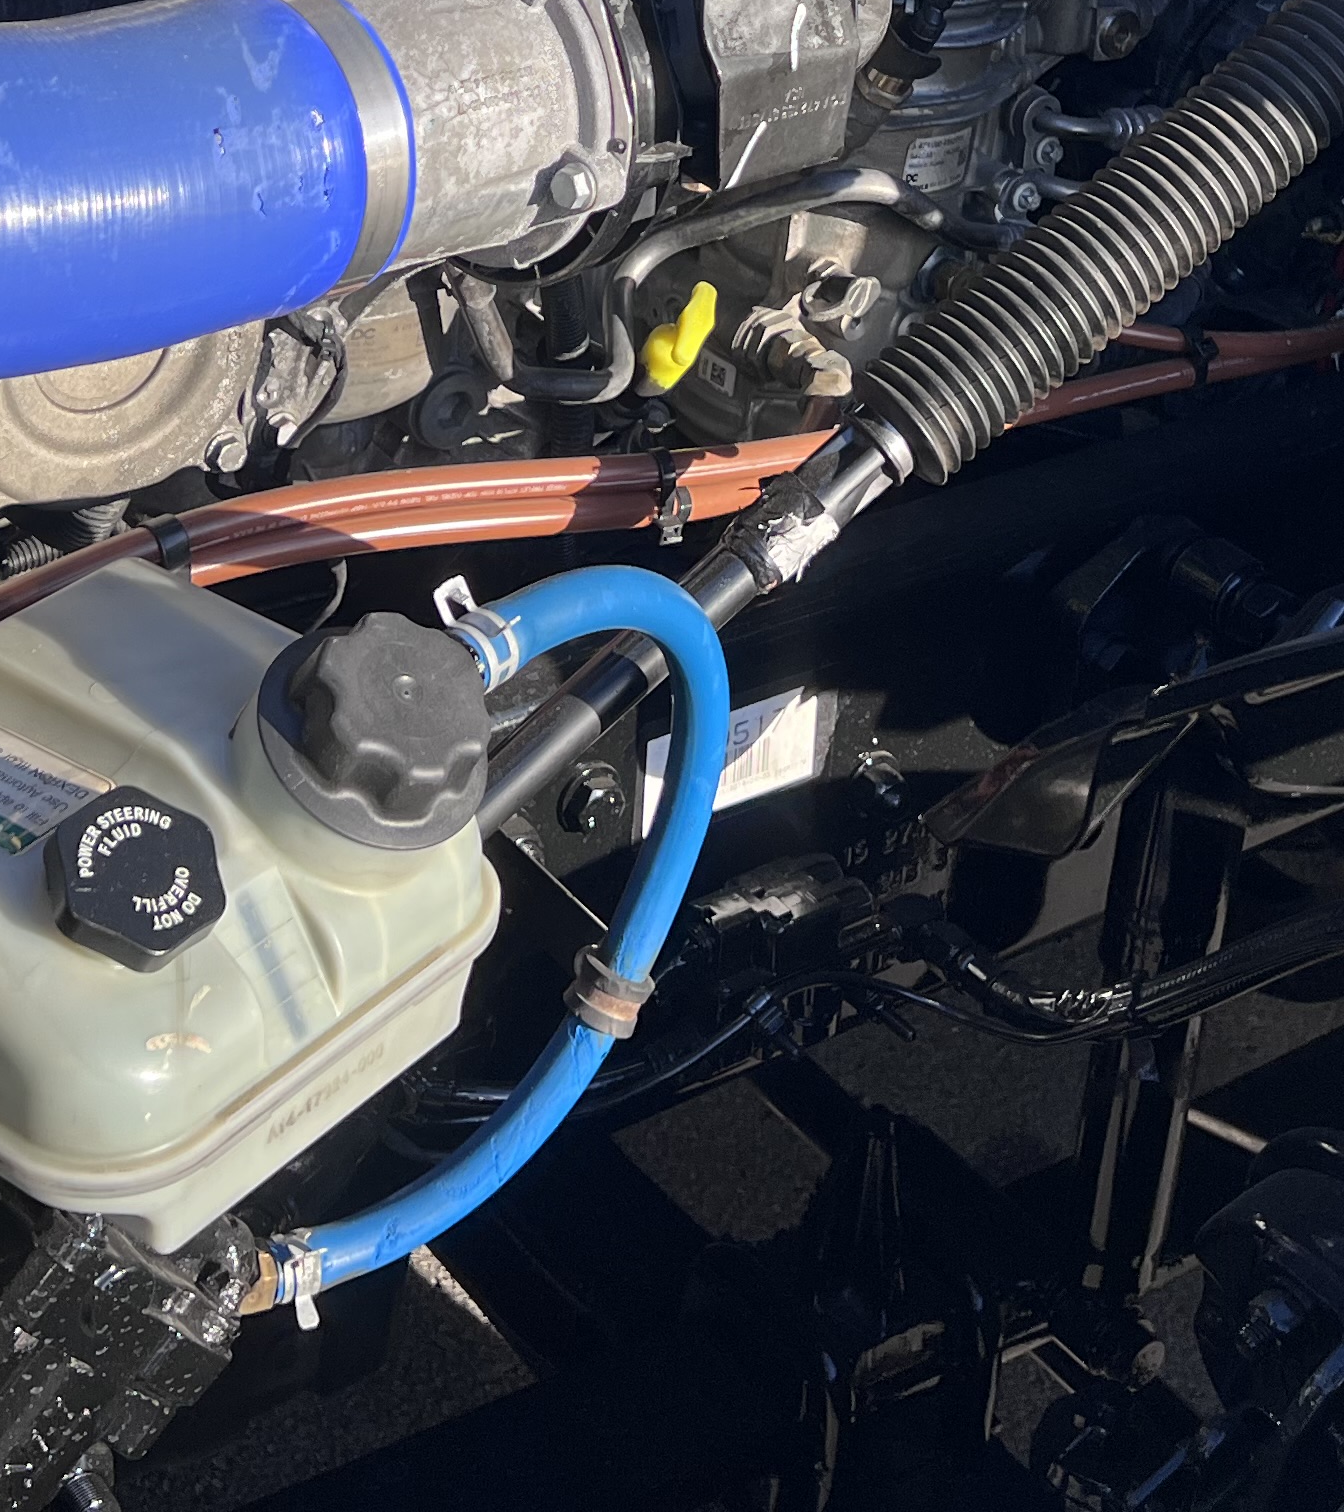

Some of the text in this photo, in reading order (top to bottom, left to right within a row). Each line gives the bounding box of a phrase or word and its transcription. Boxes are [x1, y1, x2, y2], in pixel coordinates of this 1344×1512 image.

[905, 173, 919, 184] DC
[351, 328, 376, 341] DC
[727, 707, 785, 747] 517
[27, 810, 50, 827] Fill
[41, 793, 69, 814] Use
[77, 806, 172, 878] POWER STEERING
[97, 822, 142, 857] FLUID
[131, 866, 190, 914] OVERFILL
[153, 891, 203, 931] DO NOT
